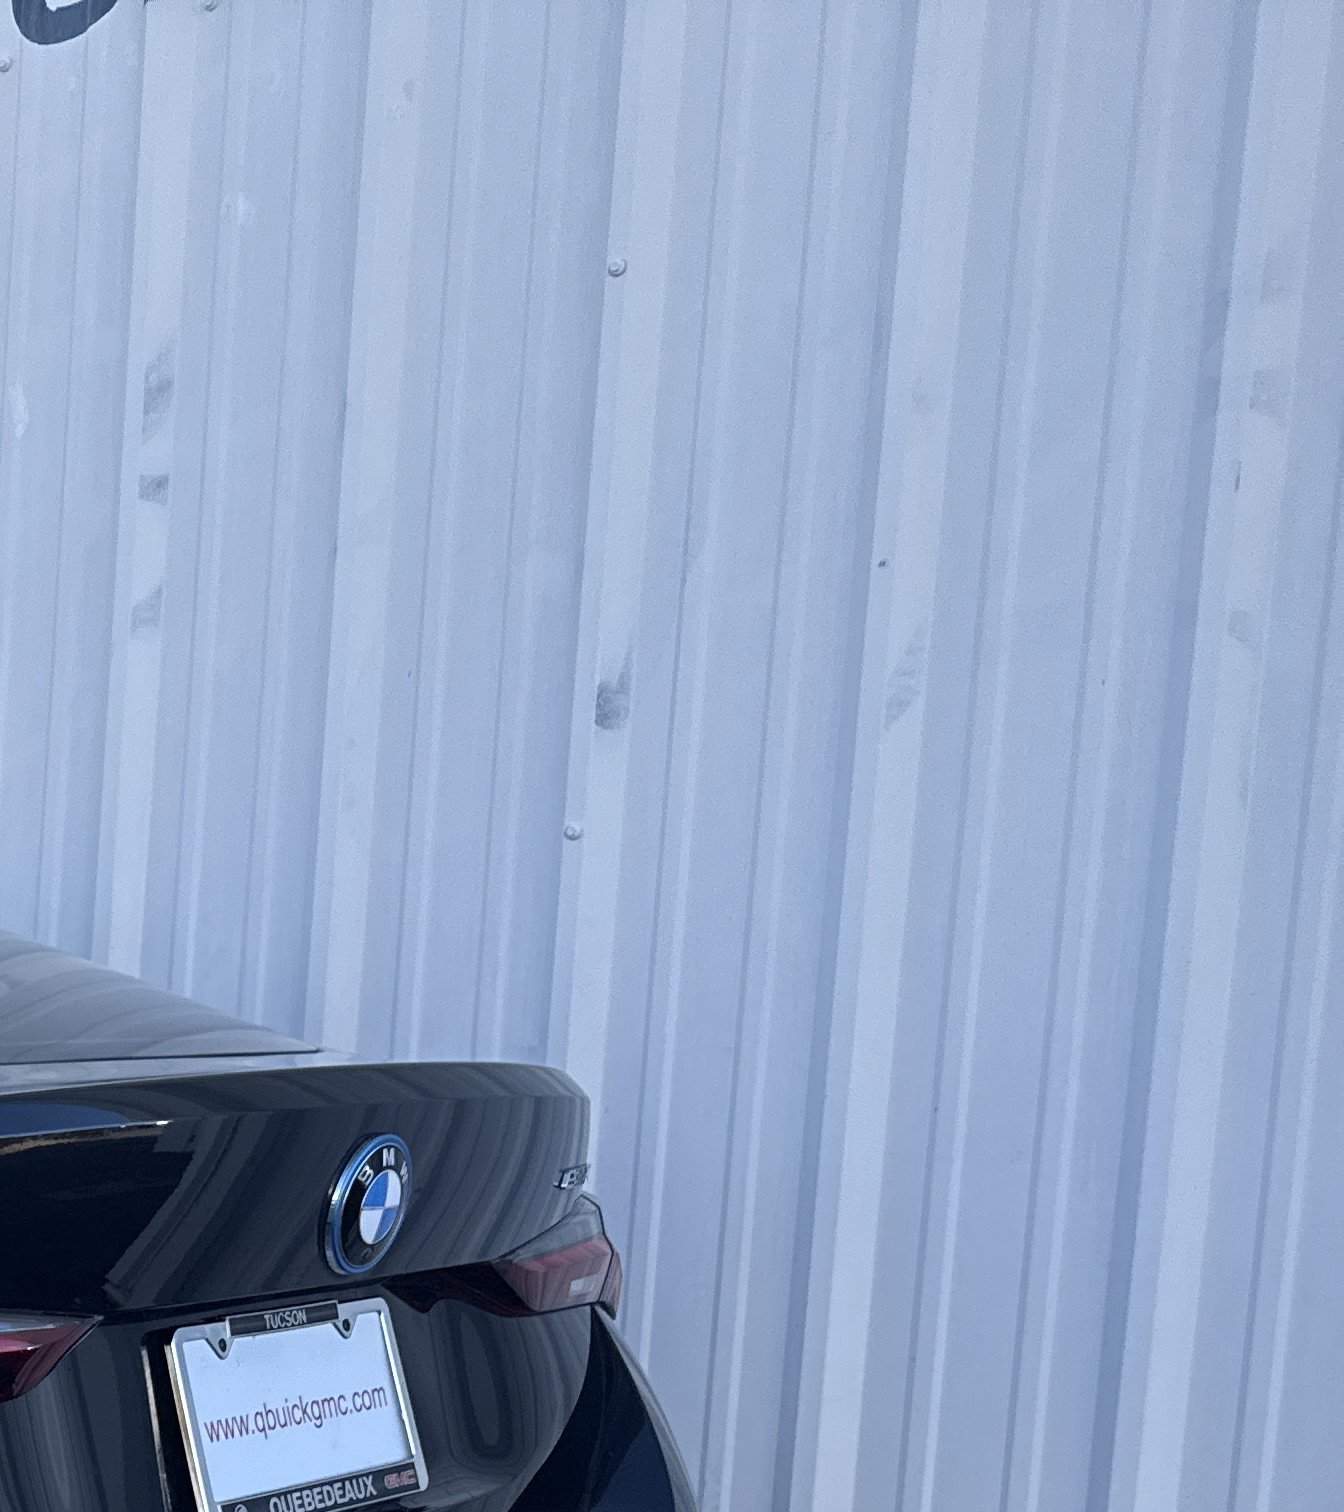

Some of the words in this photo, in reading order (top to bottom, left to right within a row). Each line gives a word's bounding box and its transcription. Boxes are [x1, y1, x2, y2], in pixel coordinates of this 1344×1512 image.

[357, 1146, 409, 1186] BMW
[263, 1308, 307, 1330] TUCSON
[204, 1385, 388, 1443] www.qbuickgmc.com
[384, 1469, 417, 1489] GMC
